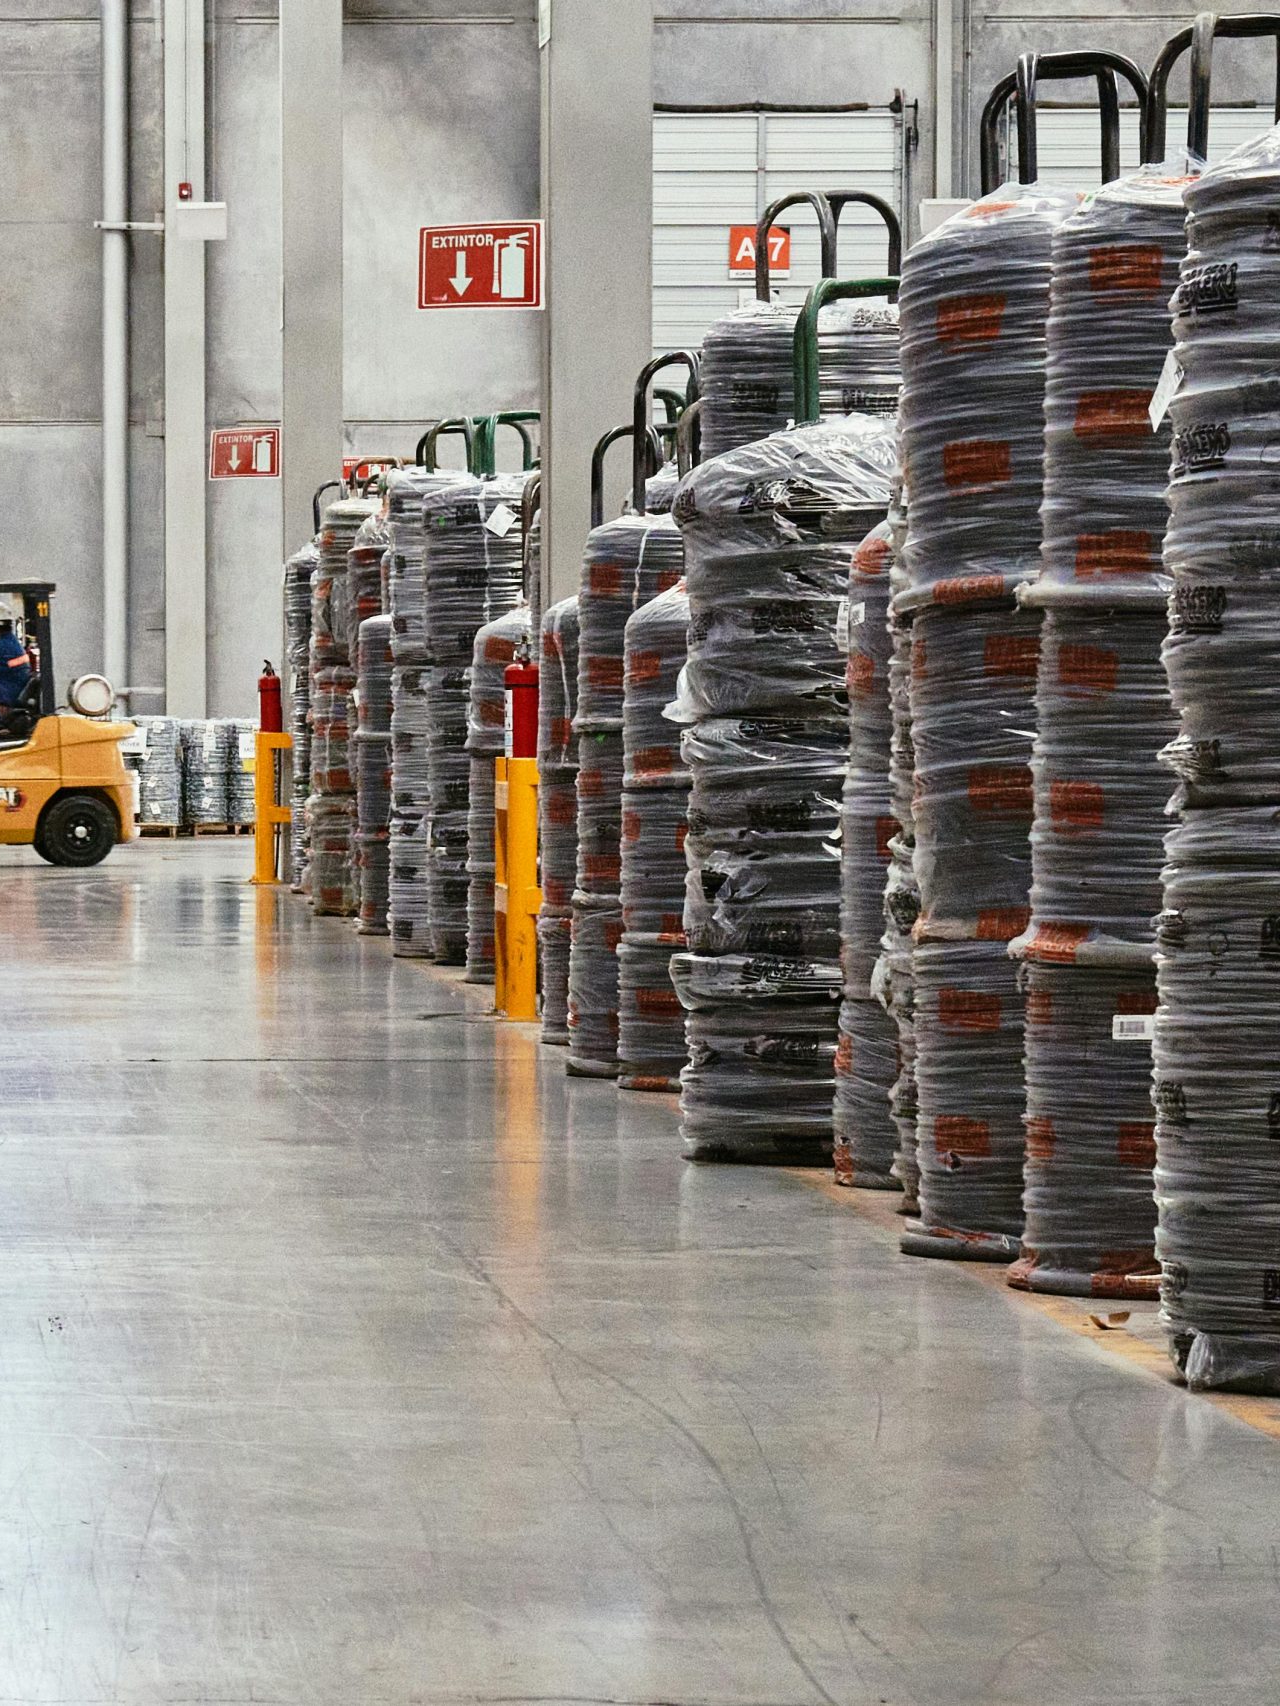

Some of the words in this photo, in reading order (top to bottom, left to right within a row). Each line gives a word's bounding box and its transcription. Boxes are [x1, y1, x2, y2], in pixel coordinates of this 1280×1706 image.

[431, 233, 494, 249] EXTINTOR
[219, 434, 254, 444] EXTINTOR
[37, 601, 48, 617] 11
